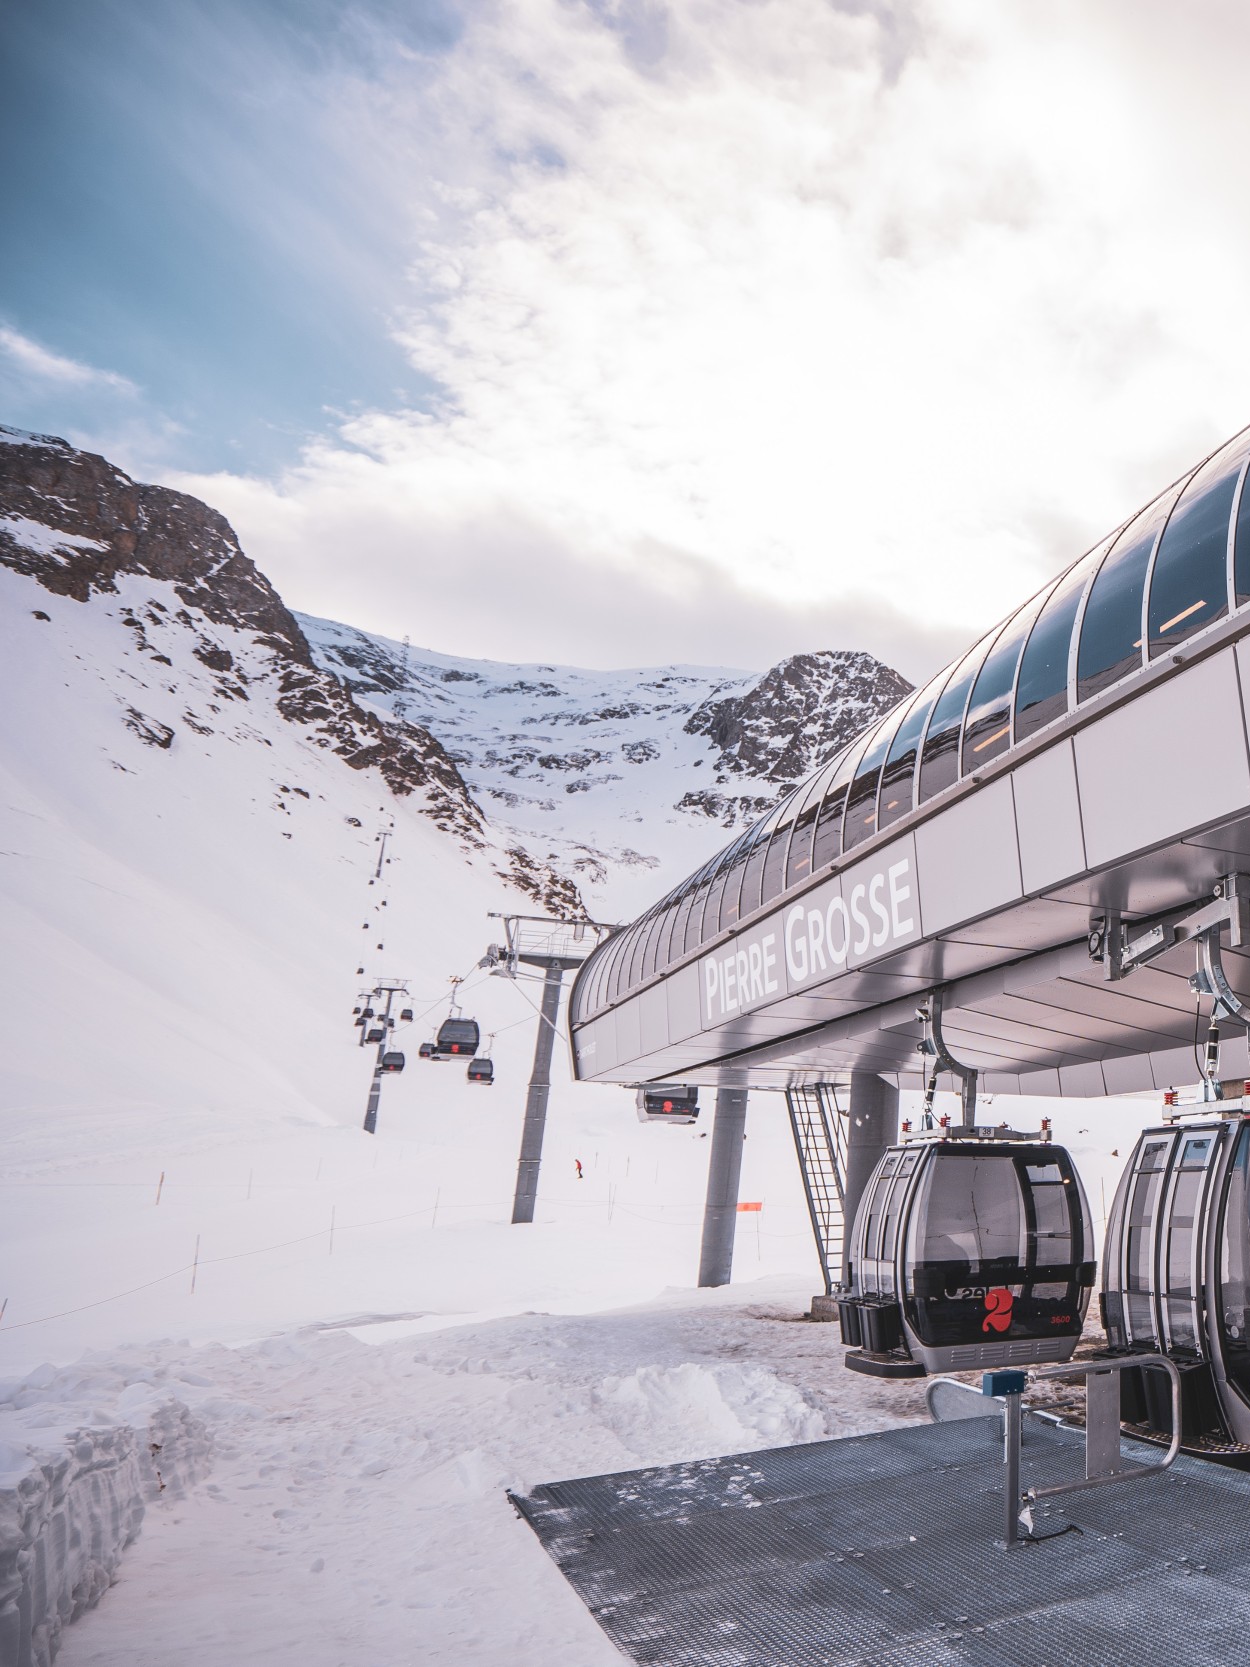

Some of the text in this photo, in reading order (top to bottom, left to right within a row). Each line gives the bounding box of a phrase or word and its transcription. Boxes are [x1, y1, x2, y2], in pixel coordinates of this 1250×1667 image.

[704, 858, 914, 1020] PIERRE GROSSE
[982, 1127, 992, 1135] 38
[982, 1288, 1013, 1332] 2
[1050, 1315, 1071, 1324] 3600
